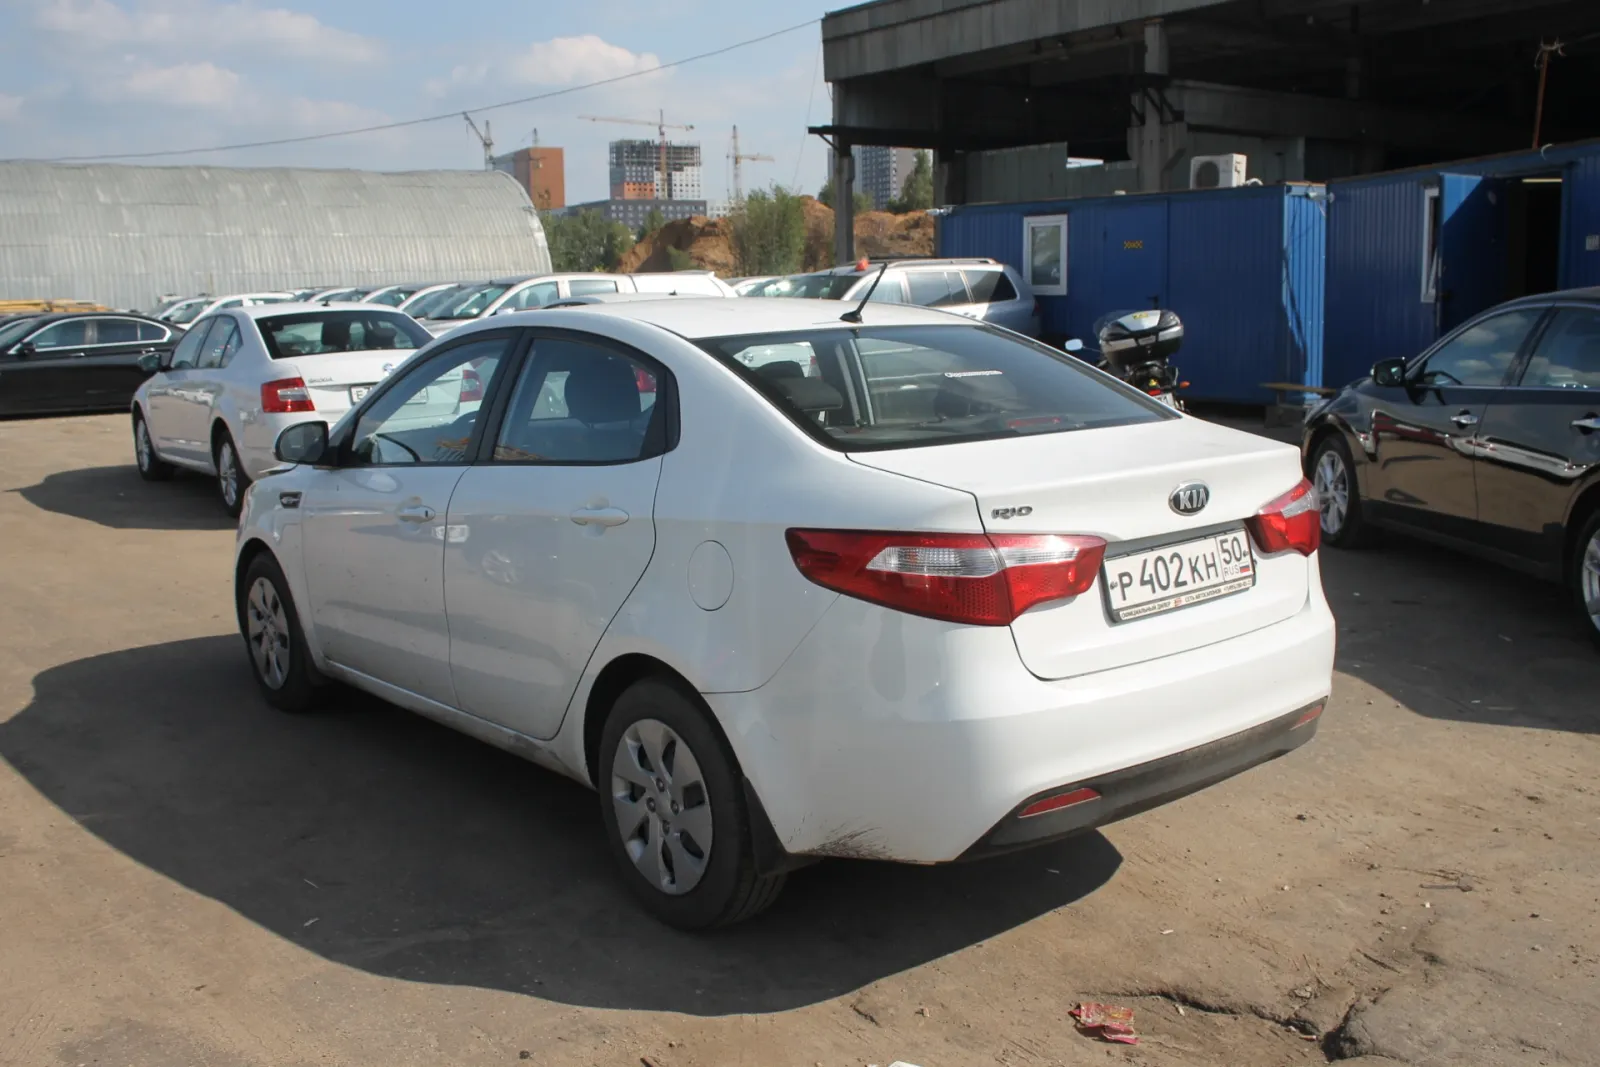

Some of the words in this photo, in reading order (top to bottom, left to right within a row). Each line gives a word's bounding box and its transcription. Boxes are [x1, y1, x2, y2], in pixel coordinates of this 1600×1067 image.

[1179, 487, 1208, 510] KIA
[991, 505, 1033, 520] RIO
[1219, 536, 1242, 565] 50
[1223, 564, 1240, 576] RUS
